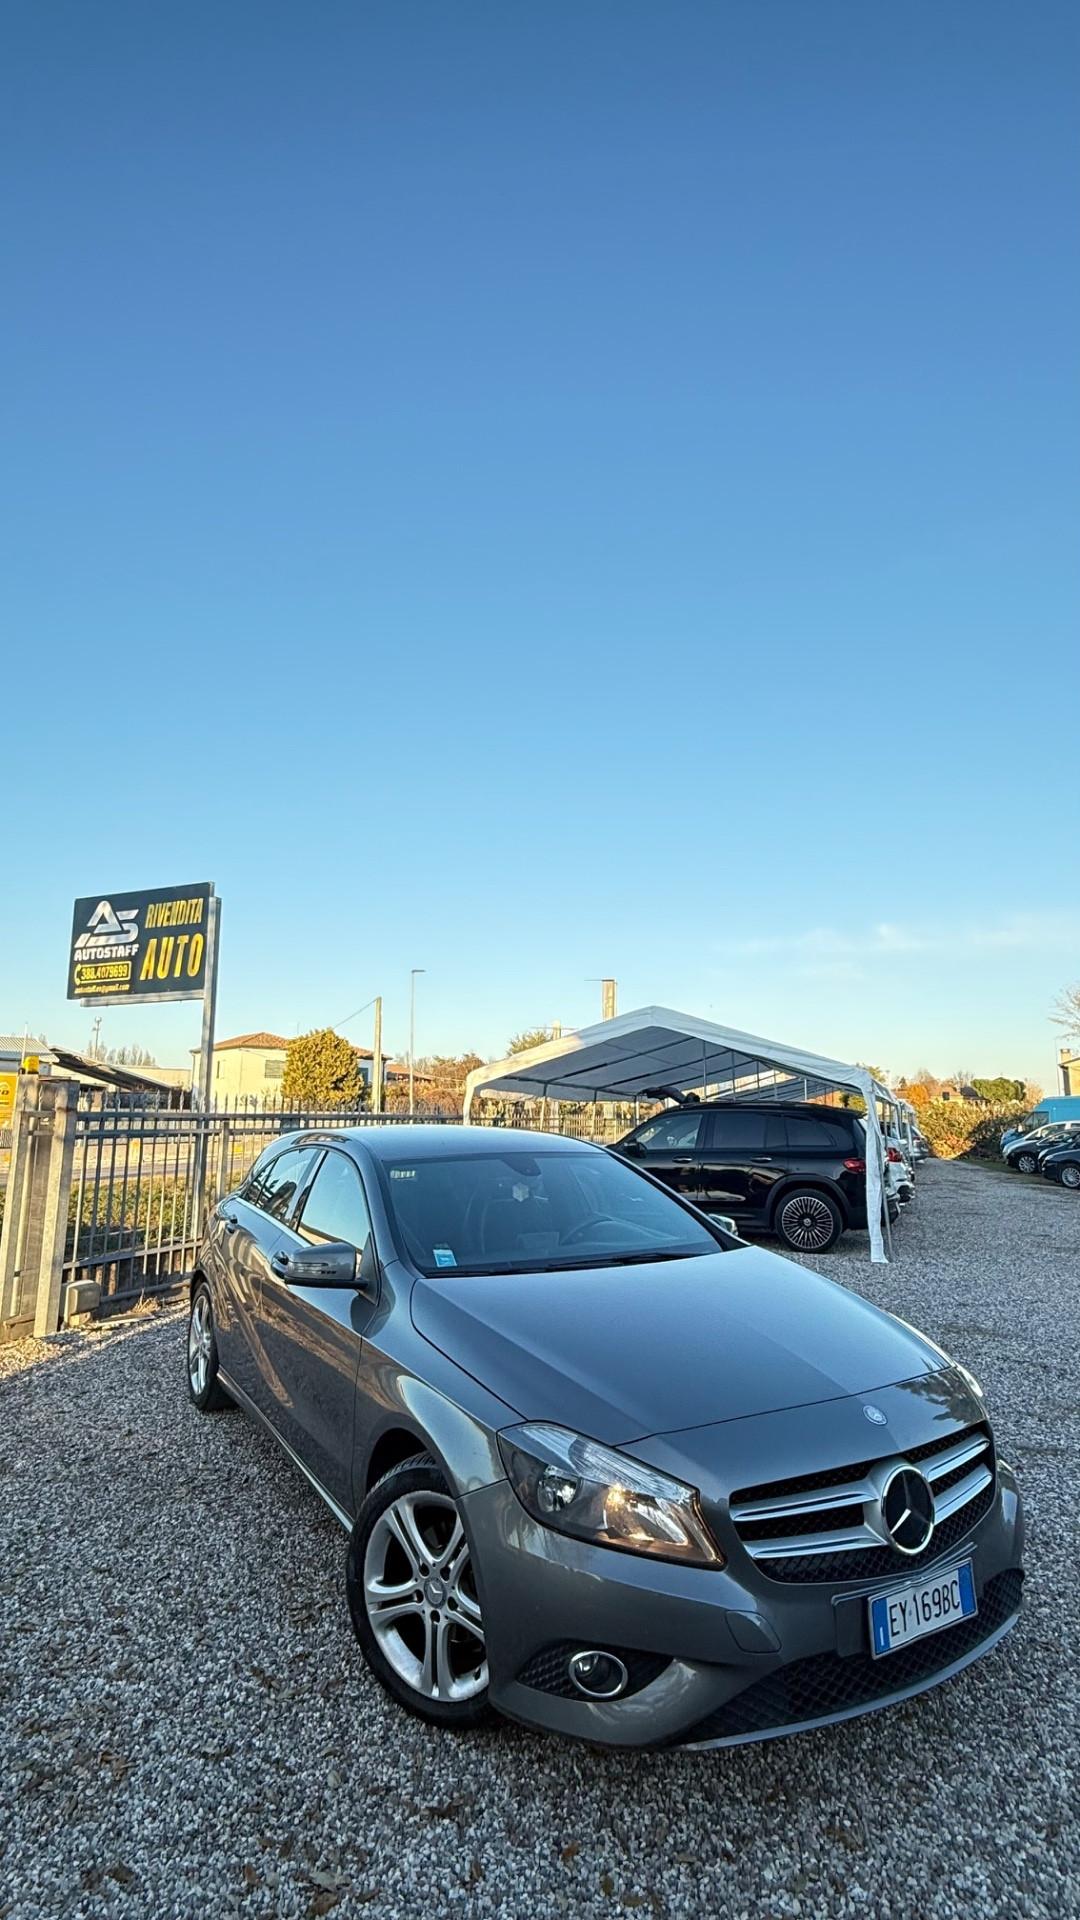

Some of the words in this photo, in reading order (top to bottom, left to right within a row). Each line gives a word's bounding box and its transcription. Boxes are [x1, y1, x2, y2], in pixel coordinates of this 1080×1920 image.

[145, 898, 204, 928] RIVENDITA
[73, 943, 139, 961] AUTOSTAFF
[139, 933, 204, 981] AUTO
